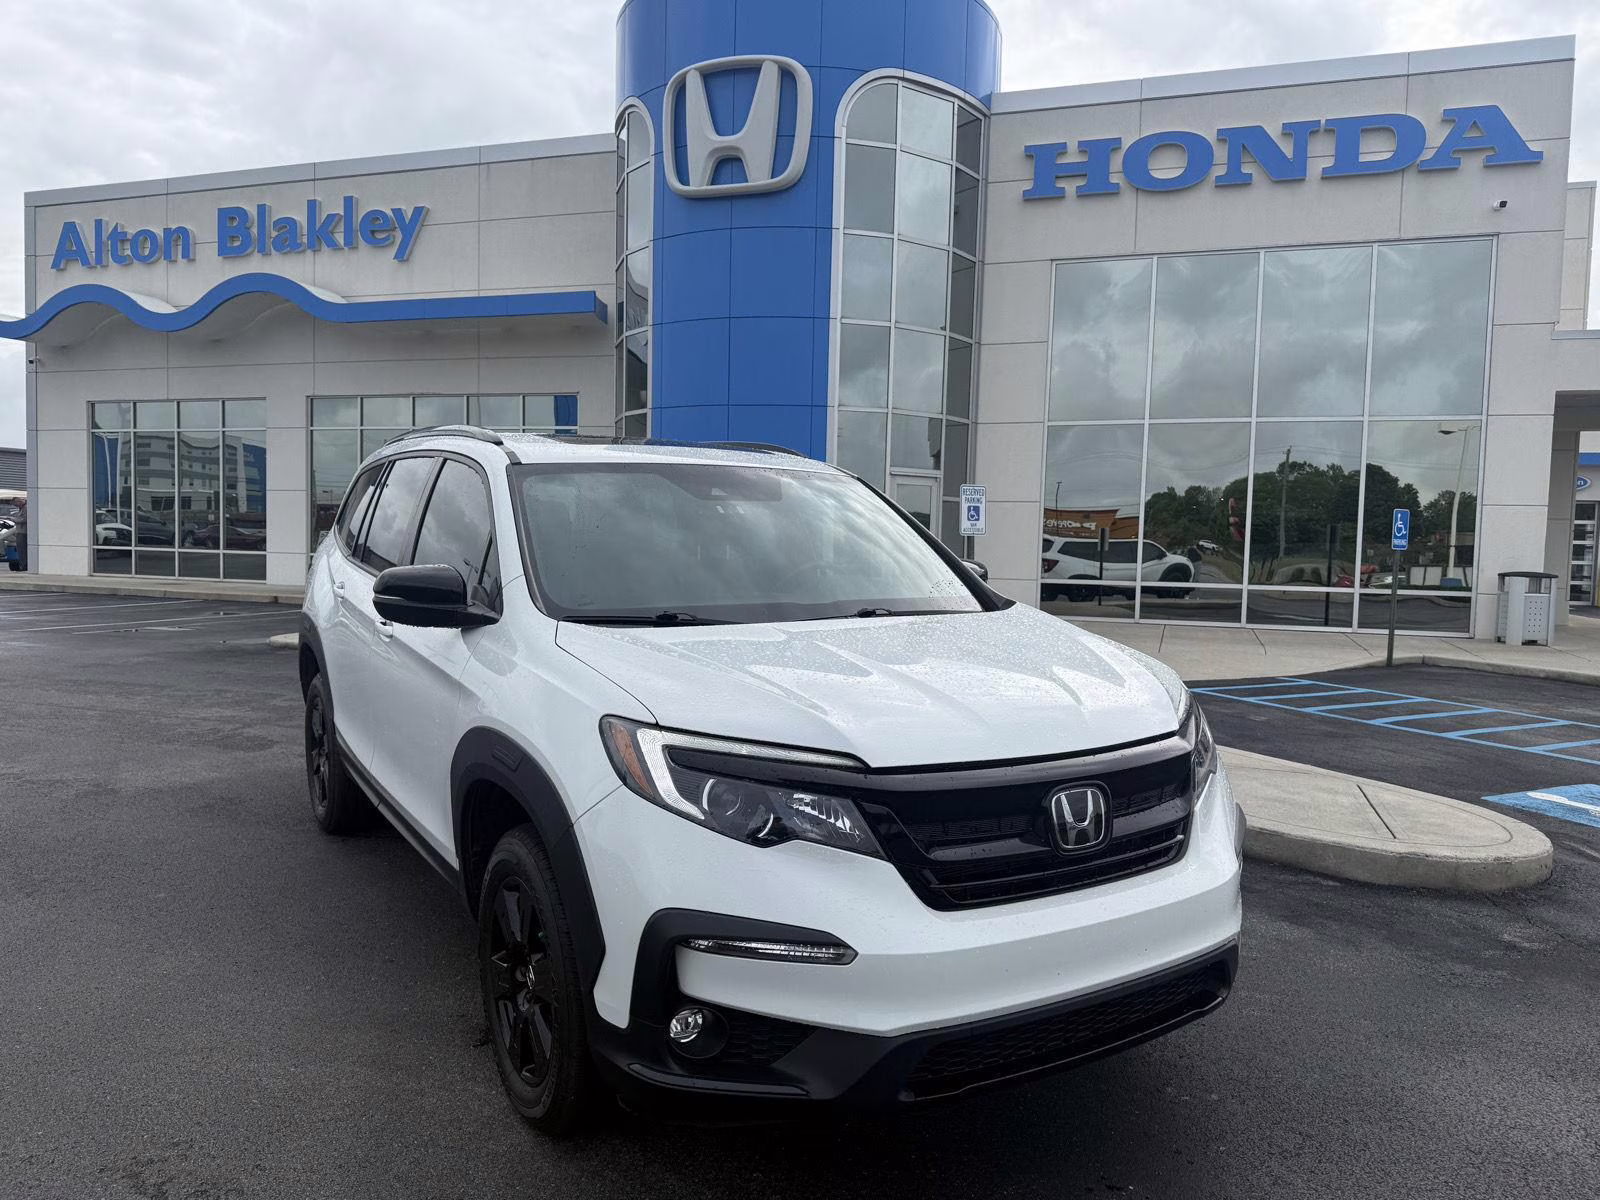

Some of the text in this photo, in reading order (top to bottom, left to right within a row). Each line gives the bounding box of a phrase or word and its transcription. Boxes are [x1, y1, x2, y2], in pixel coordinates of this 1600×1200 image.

[1023, 105, 1543, 200] HONDA
[51, 195, 429, 271] Alton Blakley
[962, 488, 984, 496] RESERVED
[964, 496, 983, 504] PARKING
